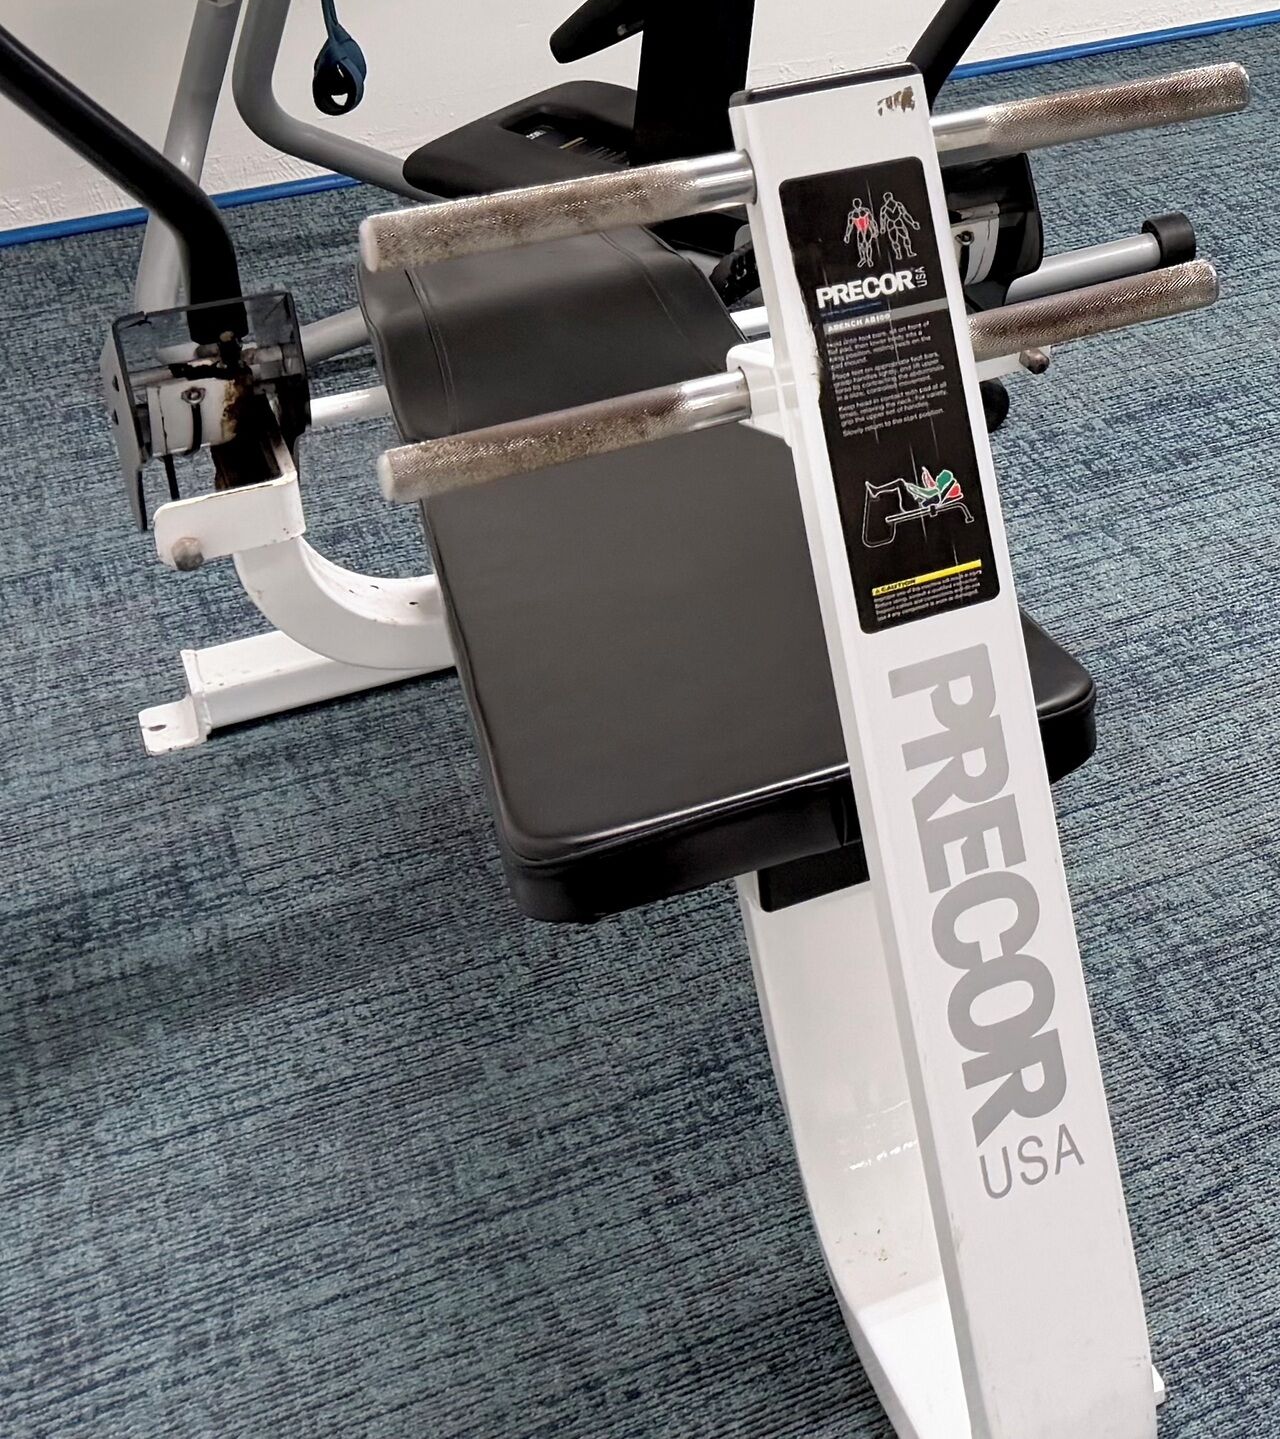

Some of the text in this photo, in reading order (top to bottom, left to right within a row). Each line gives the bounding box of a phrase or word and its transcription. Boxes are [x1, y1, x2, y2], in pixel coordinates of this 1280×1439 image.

[816, 270, 915, 308] PRECOR
[915, 265, 928, 287] USA
[888, 643, 1067, 1146] PRECOR
[980, 1123, 1085, 1200] USA
